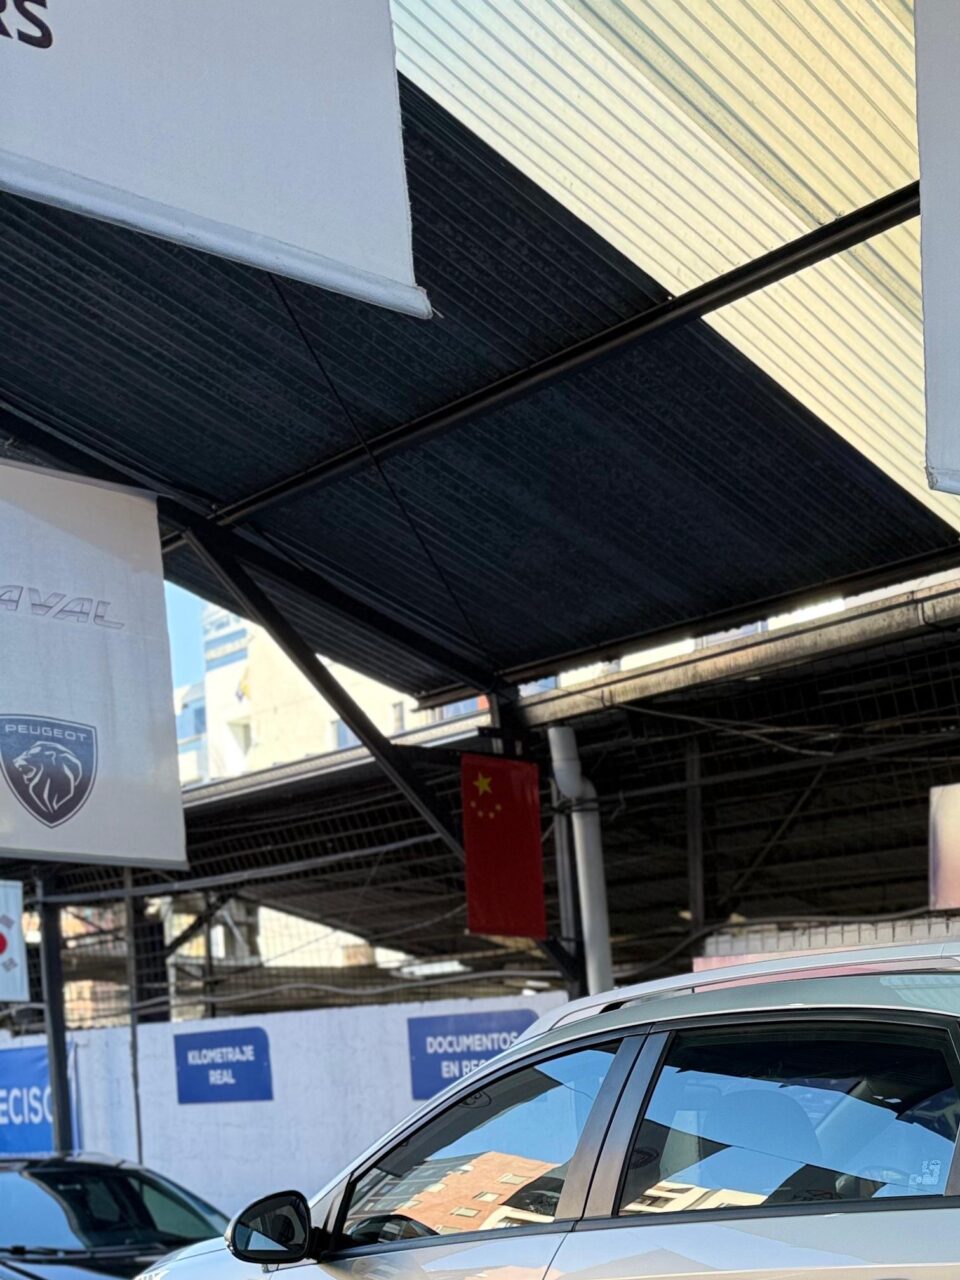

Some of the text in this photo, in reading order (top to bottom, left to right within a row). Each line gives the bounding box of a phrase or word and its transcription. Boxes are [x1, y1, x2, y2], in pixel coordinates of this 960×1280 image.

[5, 723, 88, 742] PEUGEOT
[426, 1032, 519, 1054] DOCUMENTOS
[187, 1045, 255, 1065] KILOMETRAJE
[209, 1069, 236, 1085] REAL
[441, 1060, 460, 1079] EN
